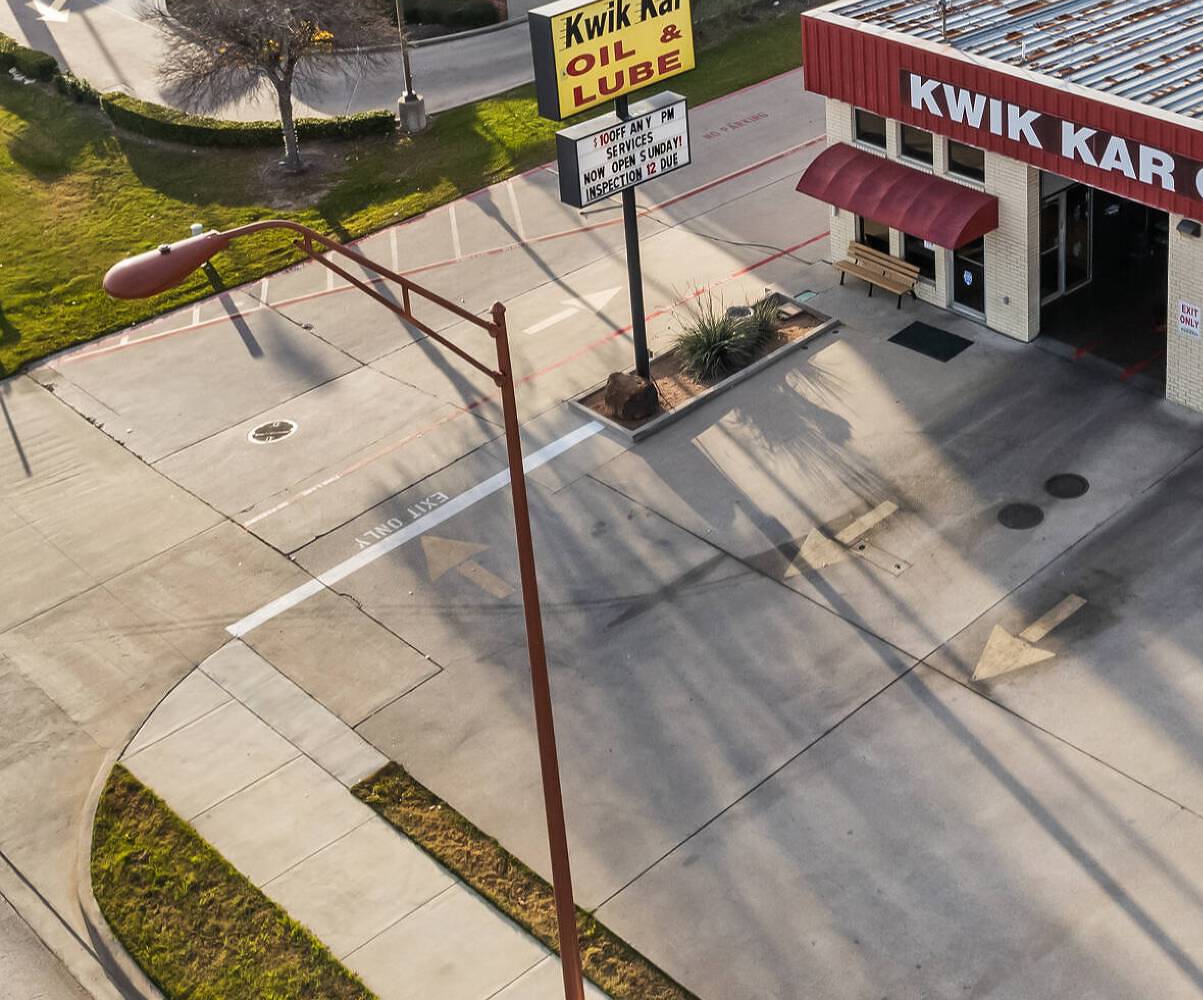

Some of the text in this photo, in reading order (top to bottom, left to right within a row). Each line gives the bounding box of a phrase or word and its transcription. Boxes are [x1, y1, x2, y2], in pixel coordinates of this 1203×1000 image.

[566, 23, 682, 77] OIL &
[573, 49, 682, 108] LUBE
[630, 116, 652, 135] ANY
[661, 107, 675, 123] PM
[909, 72, 1043, 149] KWIK
[1061, 120, 1176, 193] KAR
[606, 131, 654, 160] SERVICES
[583, 166, 606, 185] NOW
[612, 153, 636, 174] OPEN
[586, 153, 679, 202] INSPECTION 12 DUE
[1180, 314, 1199, 328] ONLY
[1181, 303, 1199, 317] EXIT
[355, 491, 449, 548] EXIT ONLY
